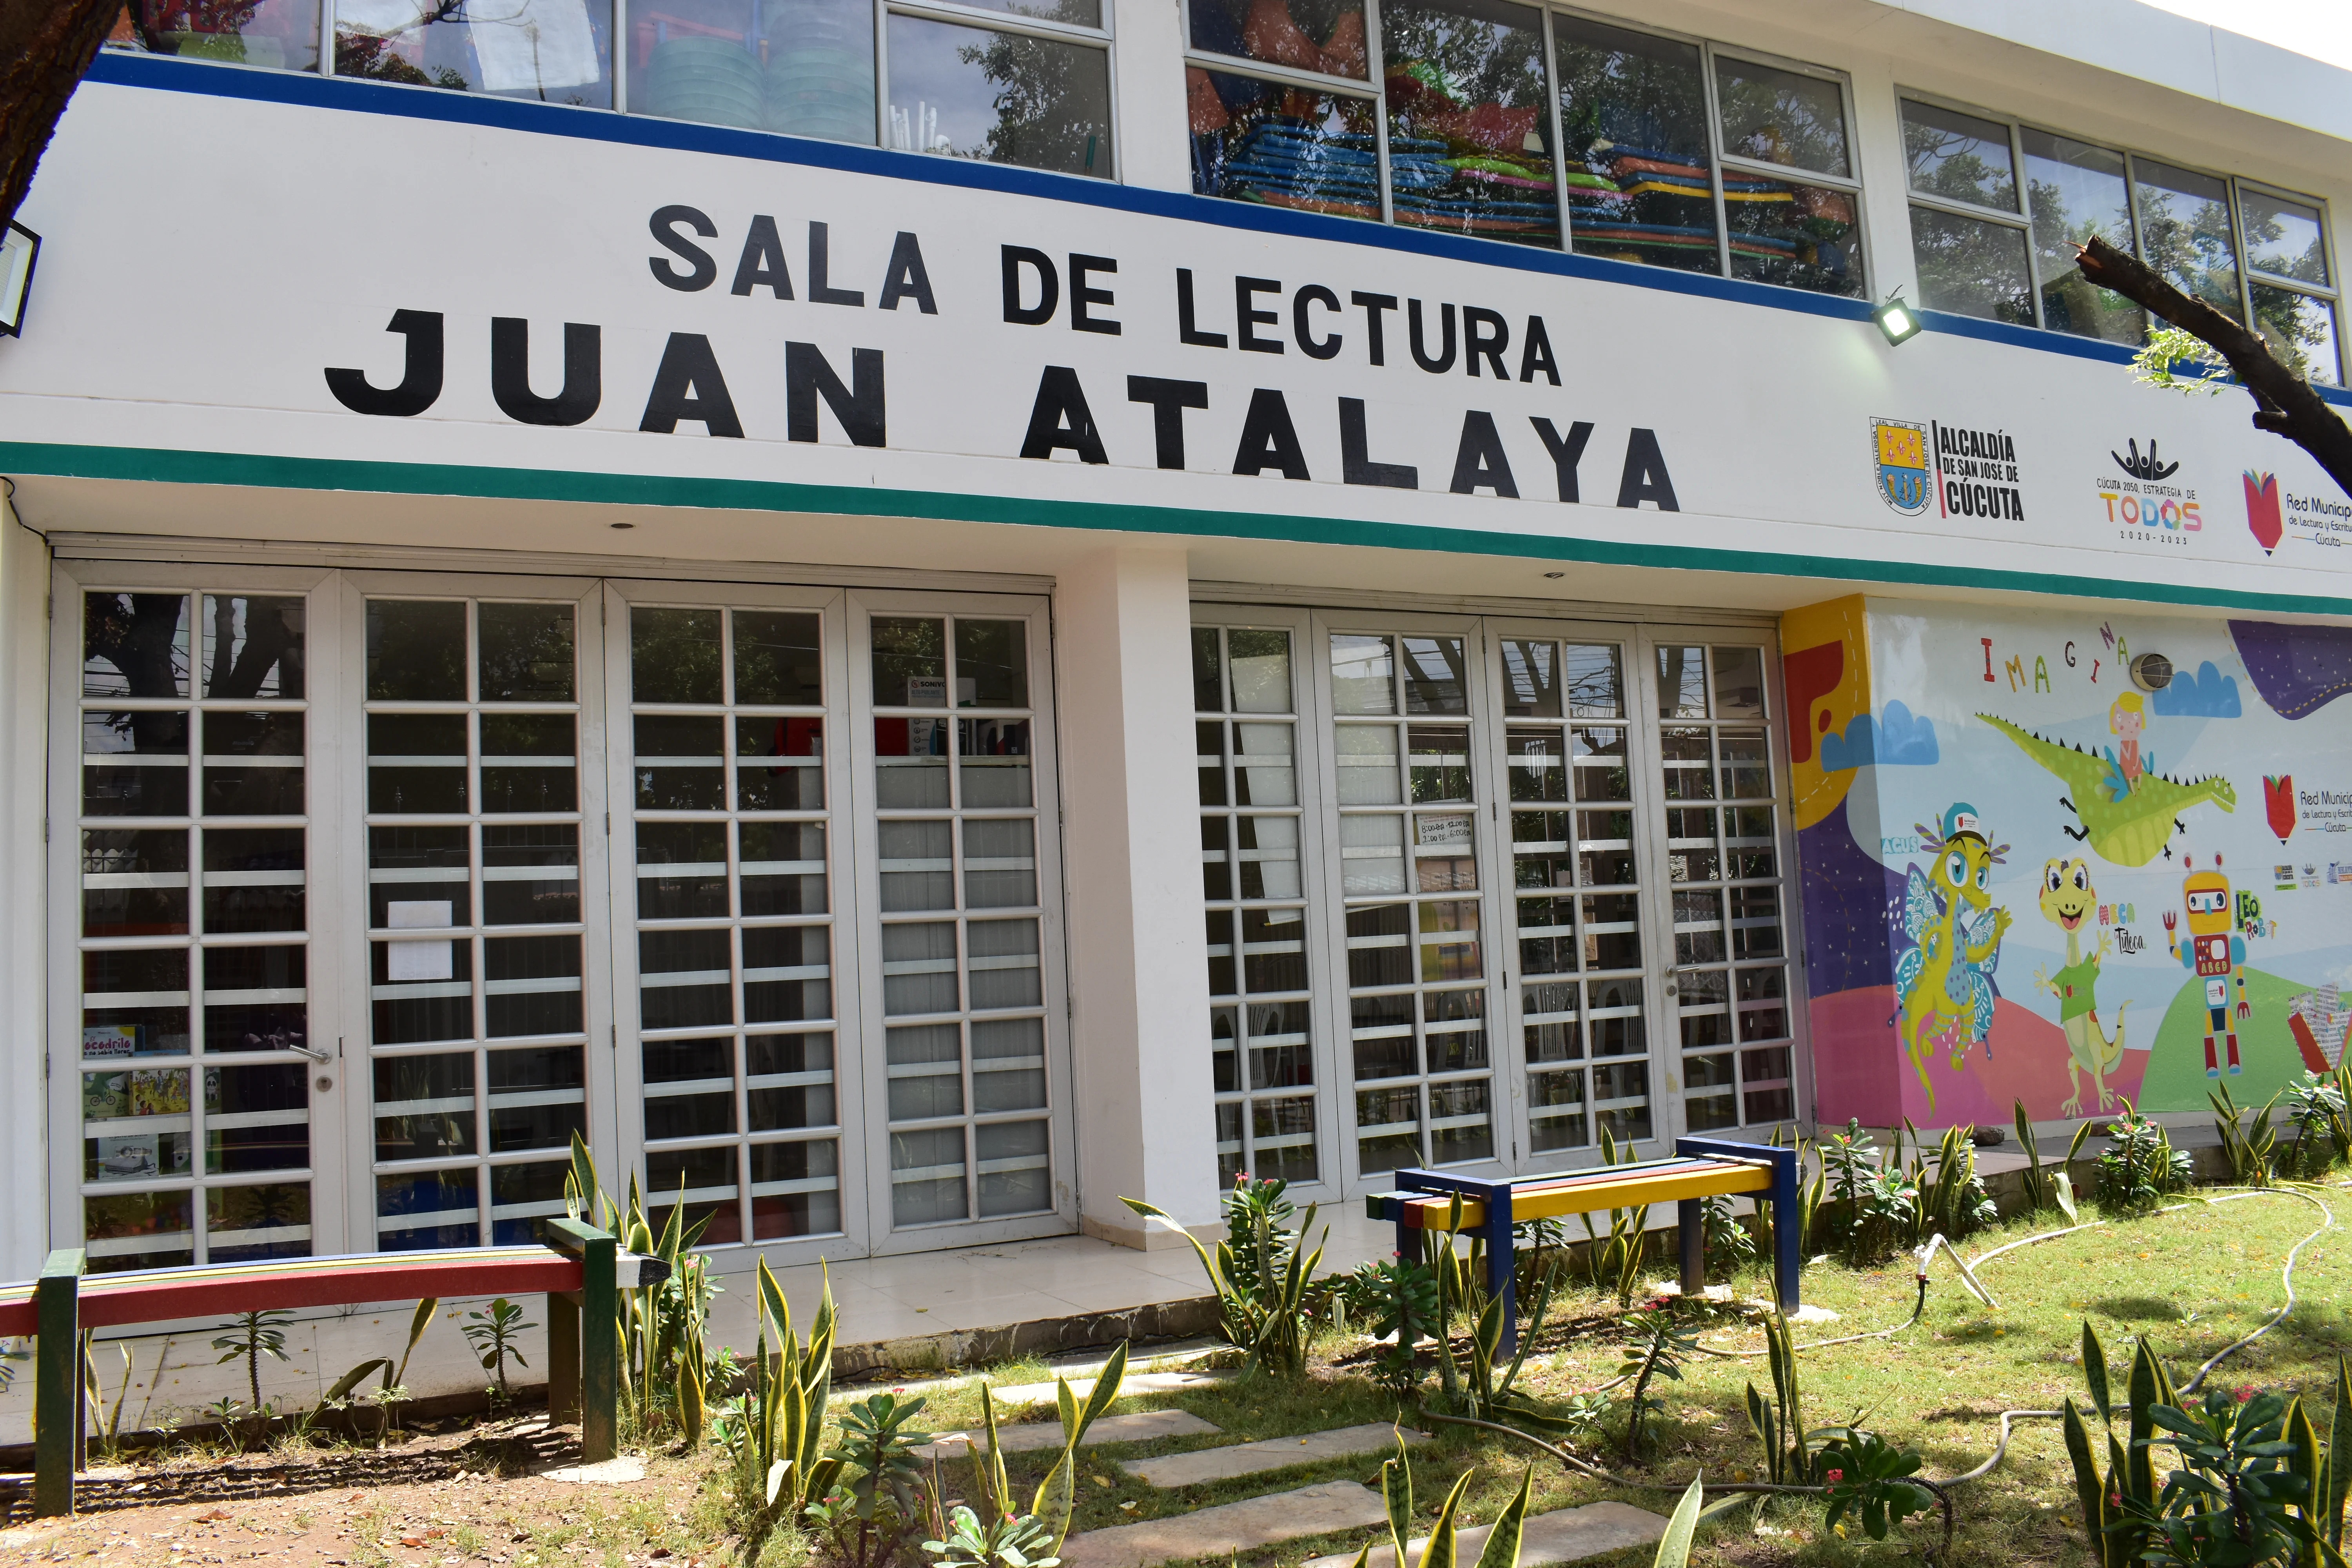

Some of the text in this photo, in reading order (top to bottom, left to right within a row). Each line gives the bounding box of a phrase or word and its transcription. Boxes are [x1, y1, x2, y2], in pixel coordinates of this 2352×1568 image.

[649, 204, 1562, 387] SALA DE LECTURA
[324, 308, 1680, 513] JUAN ATALAYA
[1940, 426, 2016, 463] ALCALDÍA
[1942, 457, 2019, 483] DE SAN JOSÉ DE
[1882, 492, 1893, 506] MUY
[1946, 477, 2024, 521] CÚCUTA
[2097, 477, 2196, 499] CÚCUTA 2050, ESTRATEGIA DE
[2099, 492, 2202, 532] TODOS
[2287, 493, 2352, 522] Red Municip
[2288, 515, 2298, 525] de
[2299, 516, 2323, 529] Lectura
[2325, 522, 2329, 532] y
[2315, 532, 2341, 547] Cúcuta
[1981, 621, 2129, 693] IMAGINA
[2301, 791, 2319, 805] Red
[2302, 809, 2310, 818] de
[2311, 809, 2332, 818] Lectura
[2333, 811, 2336, 820] y
[2325, 822, 2346, 832] Cúcuta
[1881, 836, 1919, 854] AGUS
[2099, 903, 2135, 926] MECA
[2236, 894, 2258, 929] LEO
[2245, 917, 2277, 941] ROBOT
